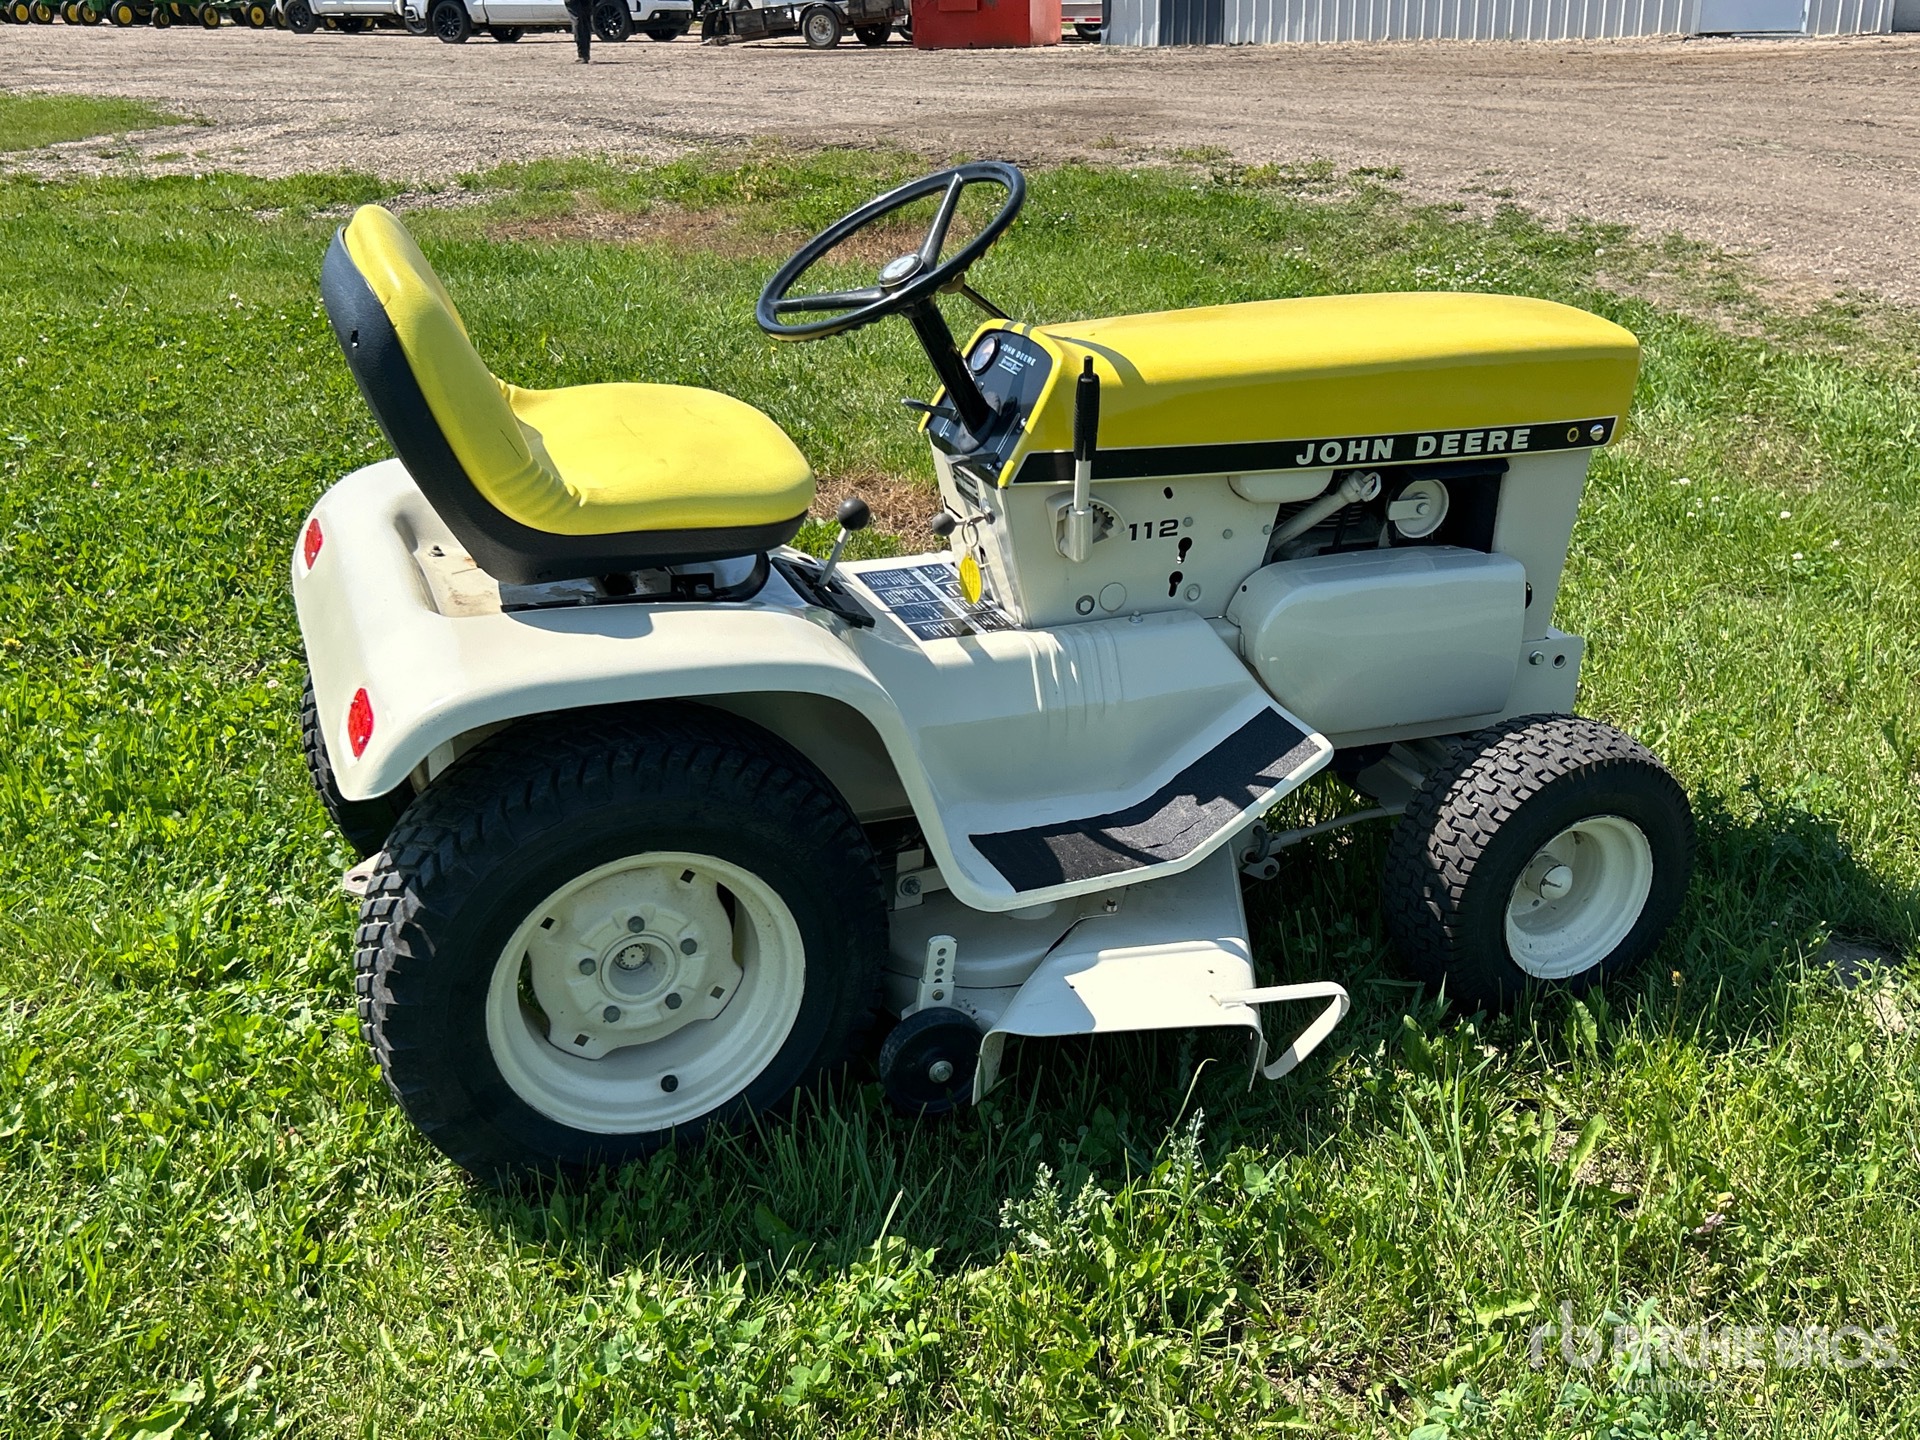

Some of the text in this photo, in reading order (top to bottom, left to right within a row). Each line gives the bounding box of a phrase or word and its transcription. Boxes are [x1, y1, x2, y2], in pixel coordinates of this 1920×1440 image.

[1000, 343, 1016, 356] JOHN
[1015, 350, 1036, 366] DEERE
[1296, 428, 1531, 466] JOHN DEERE
[1128, 519, 1179, 541] 112
